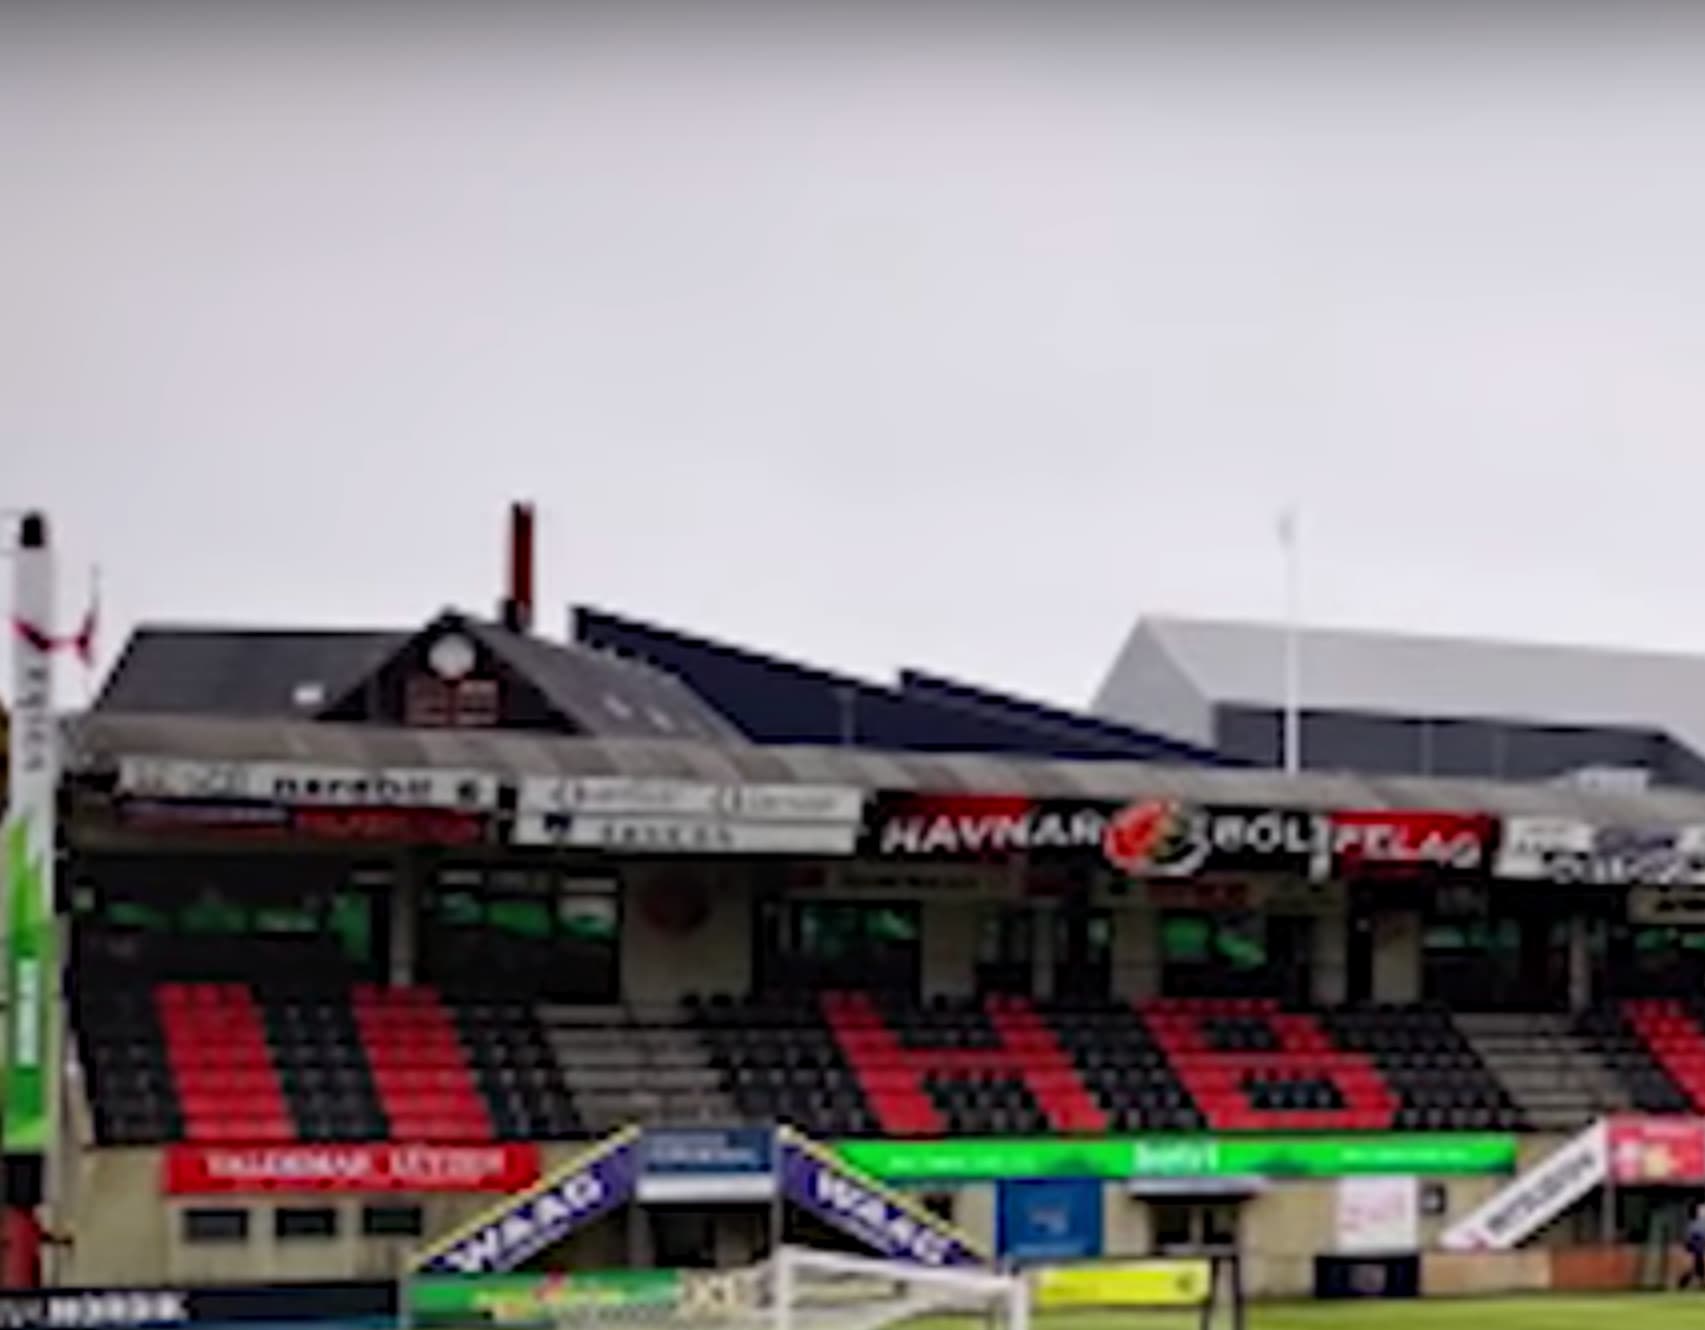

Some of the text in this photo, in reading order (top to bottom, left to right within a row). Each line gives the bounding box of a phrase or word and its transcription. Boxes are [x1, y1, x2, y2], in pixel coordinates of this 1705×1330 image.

[879, 806, 1100, 853] HAVNAR
[448, 1170, 602, 1274] WAAG
[814, 1168, 949, 1266] WAAG
